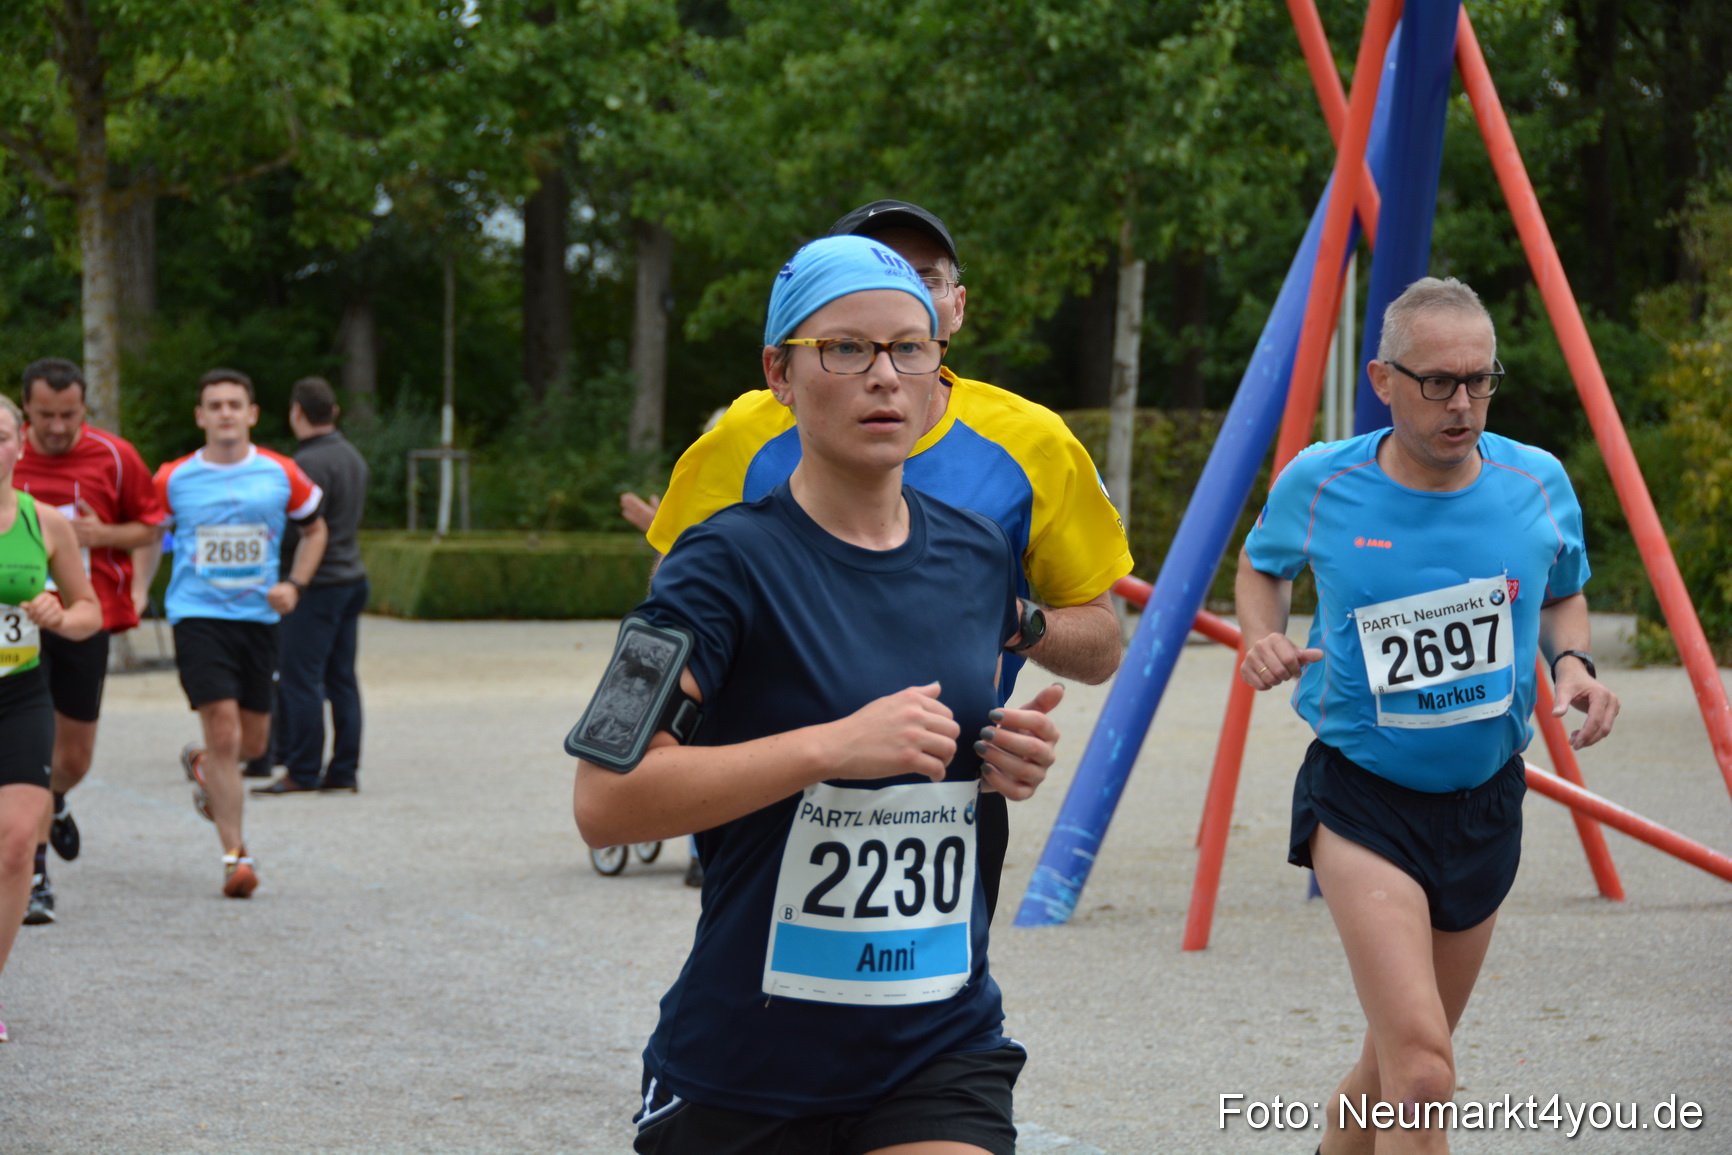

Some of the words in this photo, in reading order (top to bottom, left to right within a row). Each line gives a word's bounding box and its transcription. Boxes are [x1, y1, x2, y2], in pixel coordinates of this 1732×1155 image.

[205, 540, 261, 562] 2689
[1362, 613, 1411, 633] PARTL
[1414, 597, 1485, 622] Neumarkt
[1381, 613, 1499, 686] 2697
[1378, 686, 1385, 694] B
[1418, 684, 1486, 710] Markus
[800, 801, 864, 828] PARTL
[869, 805, 957, 826] Neumarkt
[801, 835, 966, 918] 2230
[784, 907, 793, 920] B
[856, 940, 916, 972] Anni
